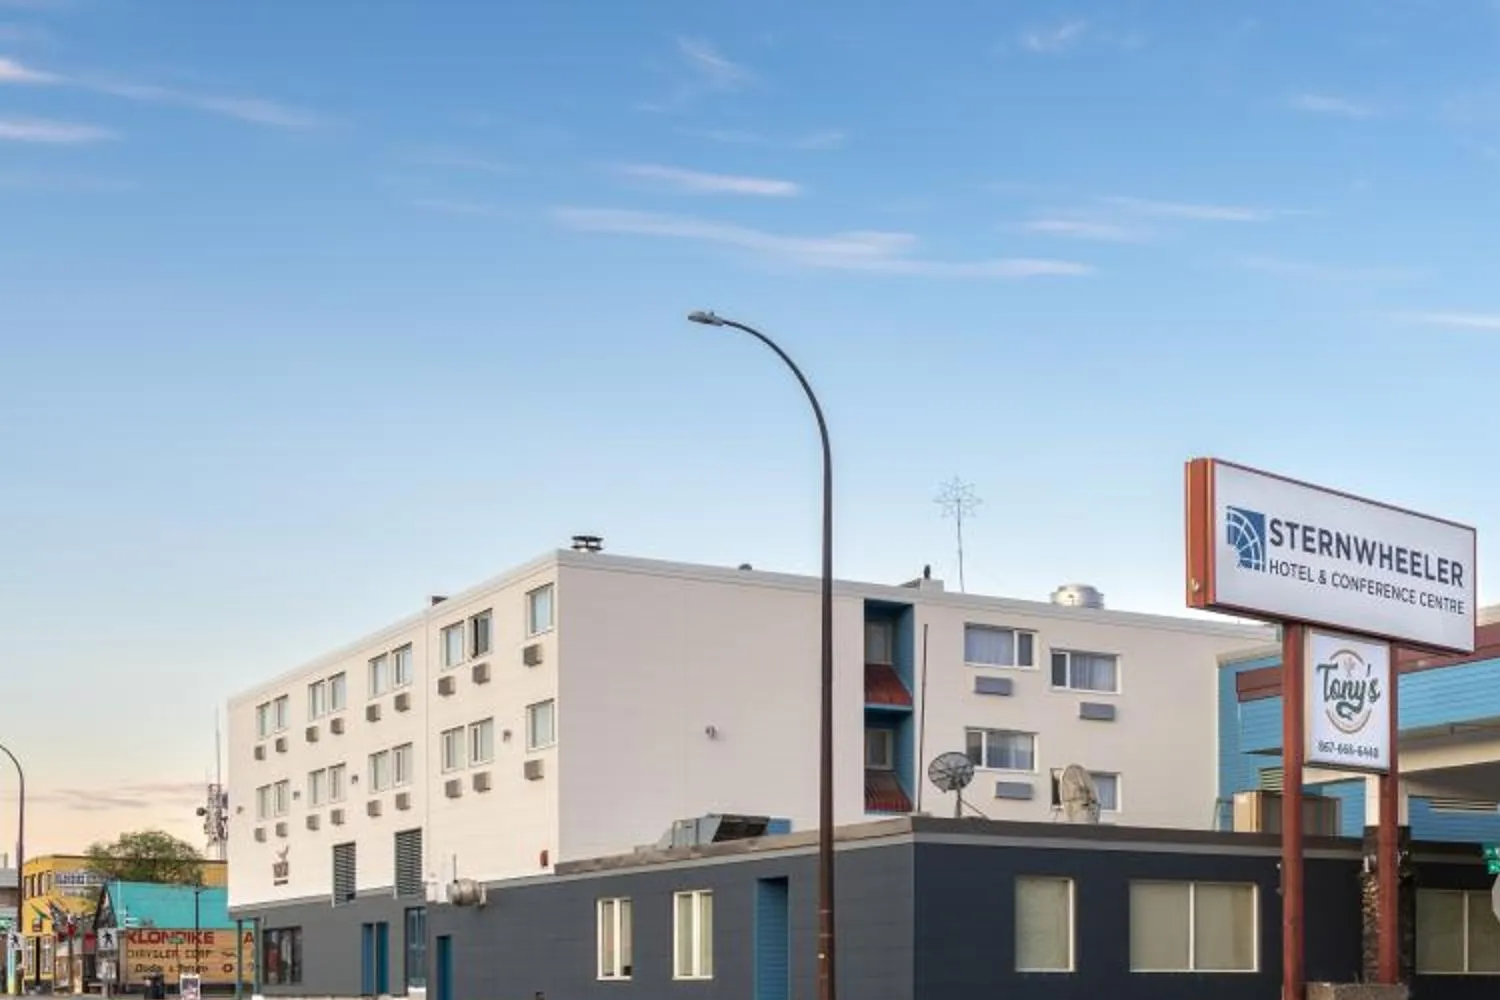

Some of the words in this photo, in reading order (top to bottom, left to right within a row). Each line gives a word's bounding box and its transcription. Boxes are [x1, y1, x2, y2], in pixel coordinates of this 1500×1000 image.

[1269, 517, 1463, 588] STERNWHEELER
[1269, 558, 1315, 583] HOTEL
[1318, 569, 1327, 585] &
[1331, 572, 1417, 605] CONFERENCE
[1420, 591, 1465, 615] CENTRE
[1316, 663, 1381, 721] Tony's
